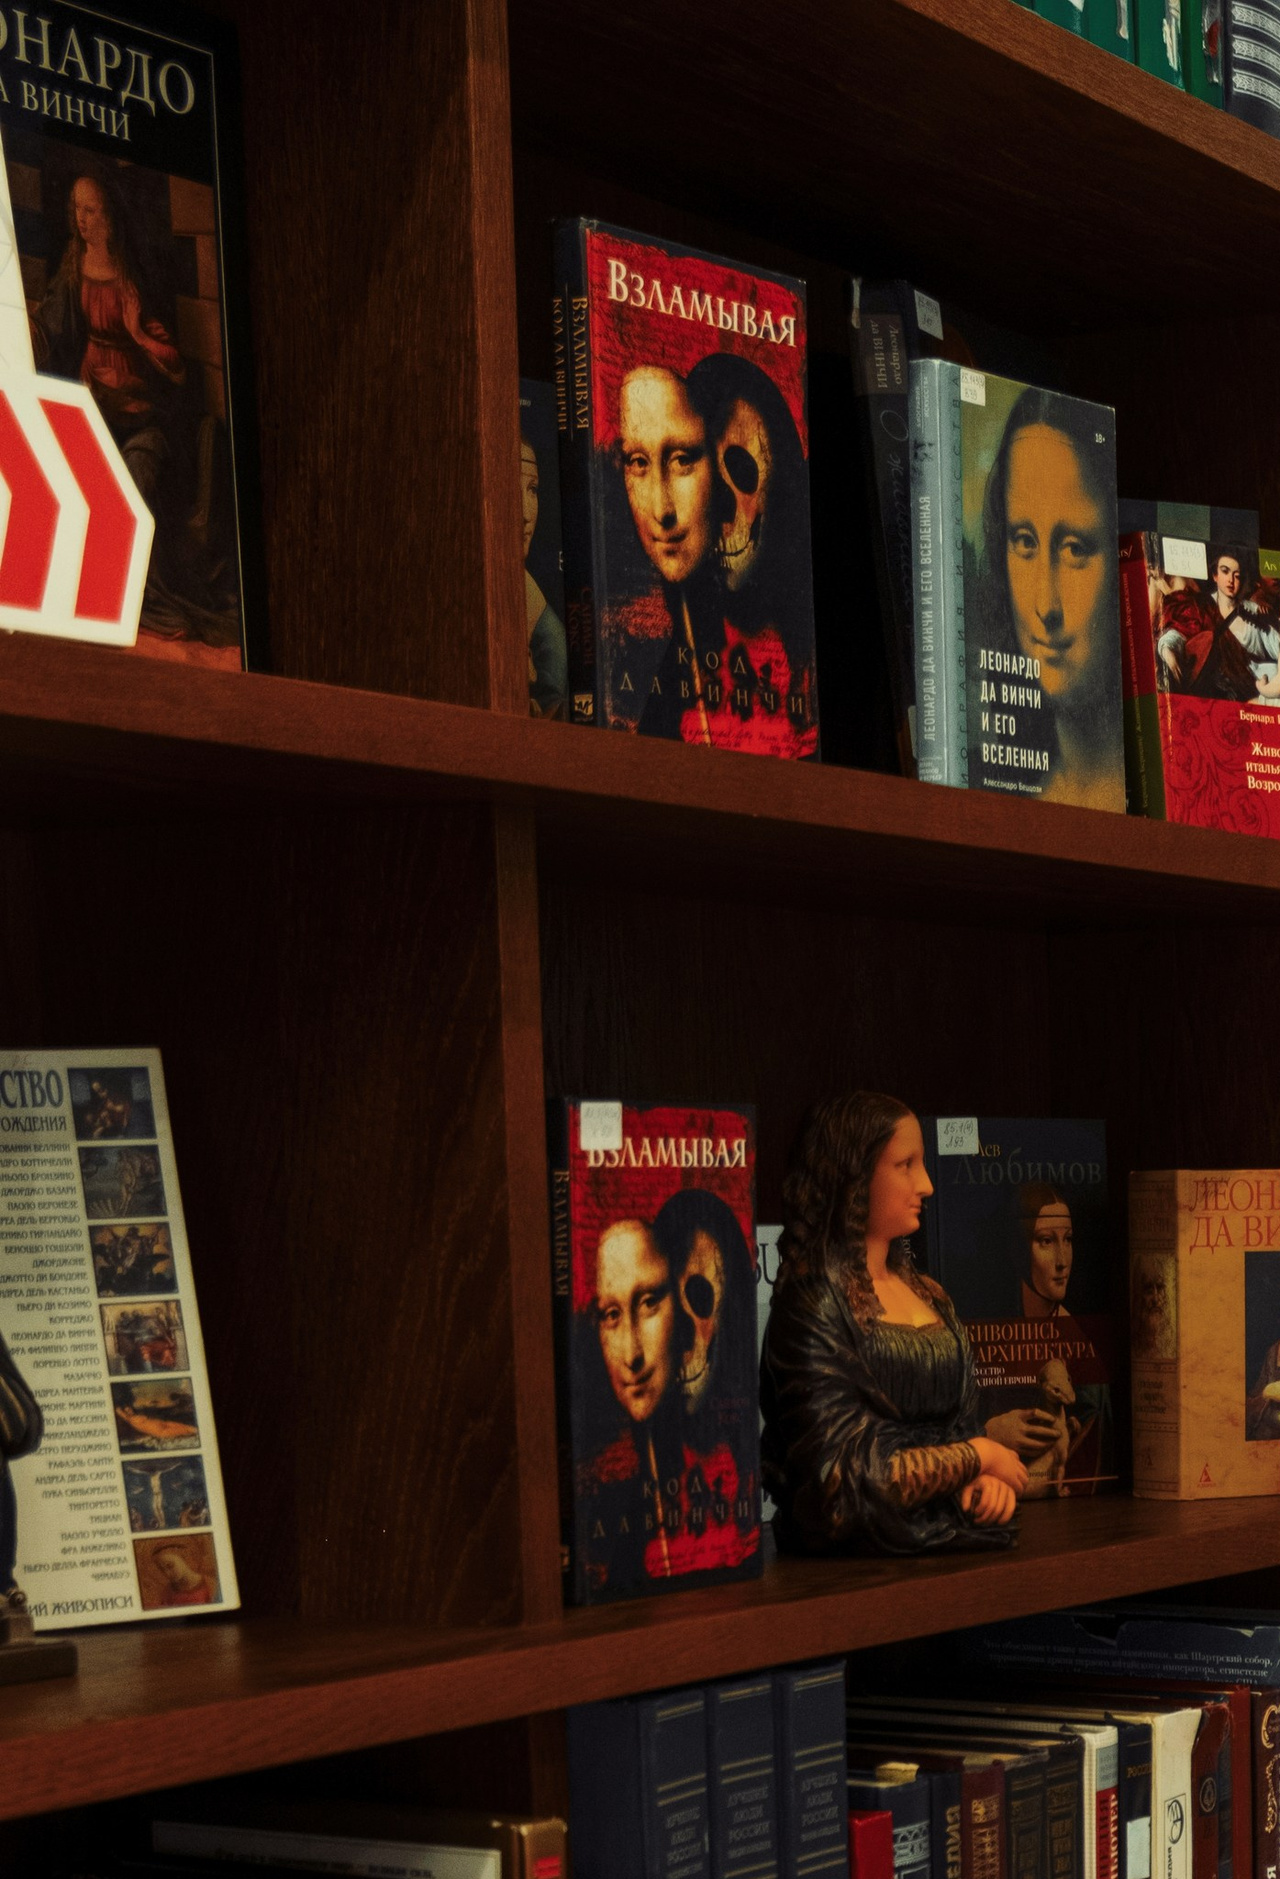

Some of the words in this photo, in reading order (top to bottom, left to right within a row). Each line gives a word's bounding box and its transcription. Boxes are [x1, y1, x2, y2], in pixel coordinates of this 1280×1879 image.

[0, 8, 195, 117] НАРДО
[20, 79, 131, 141] ВИНЧИ
[918, 495, 932, 565] ВСЕЛЕННАЯ
[919, 568, 933, 591] ЕГО
[1263, 560, 1278, 572] Ars
[921, 608, 934, 651] ВИНЧИ
[677, 647, 748, 674] КОД
[921, 656, 935, 674] ДА
[979, 649, 1041, 681] ЛЕОНАРДО
[922, 678, 936, 741] ЛЕОНАРДО
[980, 680, 997, 704] ДА
[1002, 683, 1042, 711] ВИНЧИ
[981, 711, 990, 733] И
[994, 712, 1017, 737] ЕГО
[1239, 708, 1275, 726] Бернард
[982, 742, 1050, 773] ВСЕЛЕННАЯ
[952, 1147, 1101, 1185] Любимов
[1190, 1215, 1236, 1255] ДА
[976, 1340, 1096, 1364] АРХИТЕКТУРА
[643, 1475, 702, 1499] КОД
[52, 1595, 134, 1616] ЖИВОПИСИ
